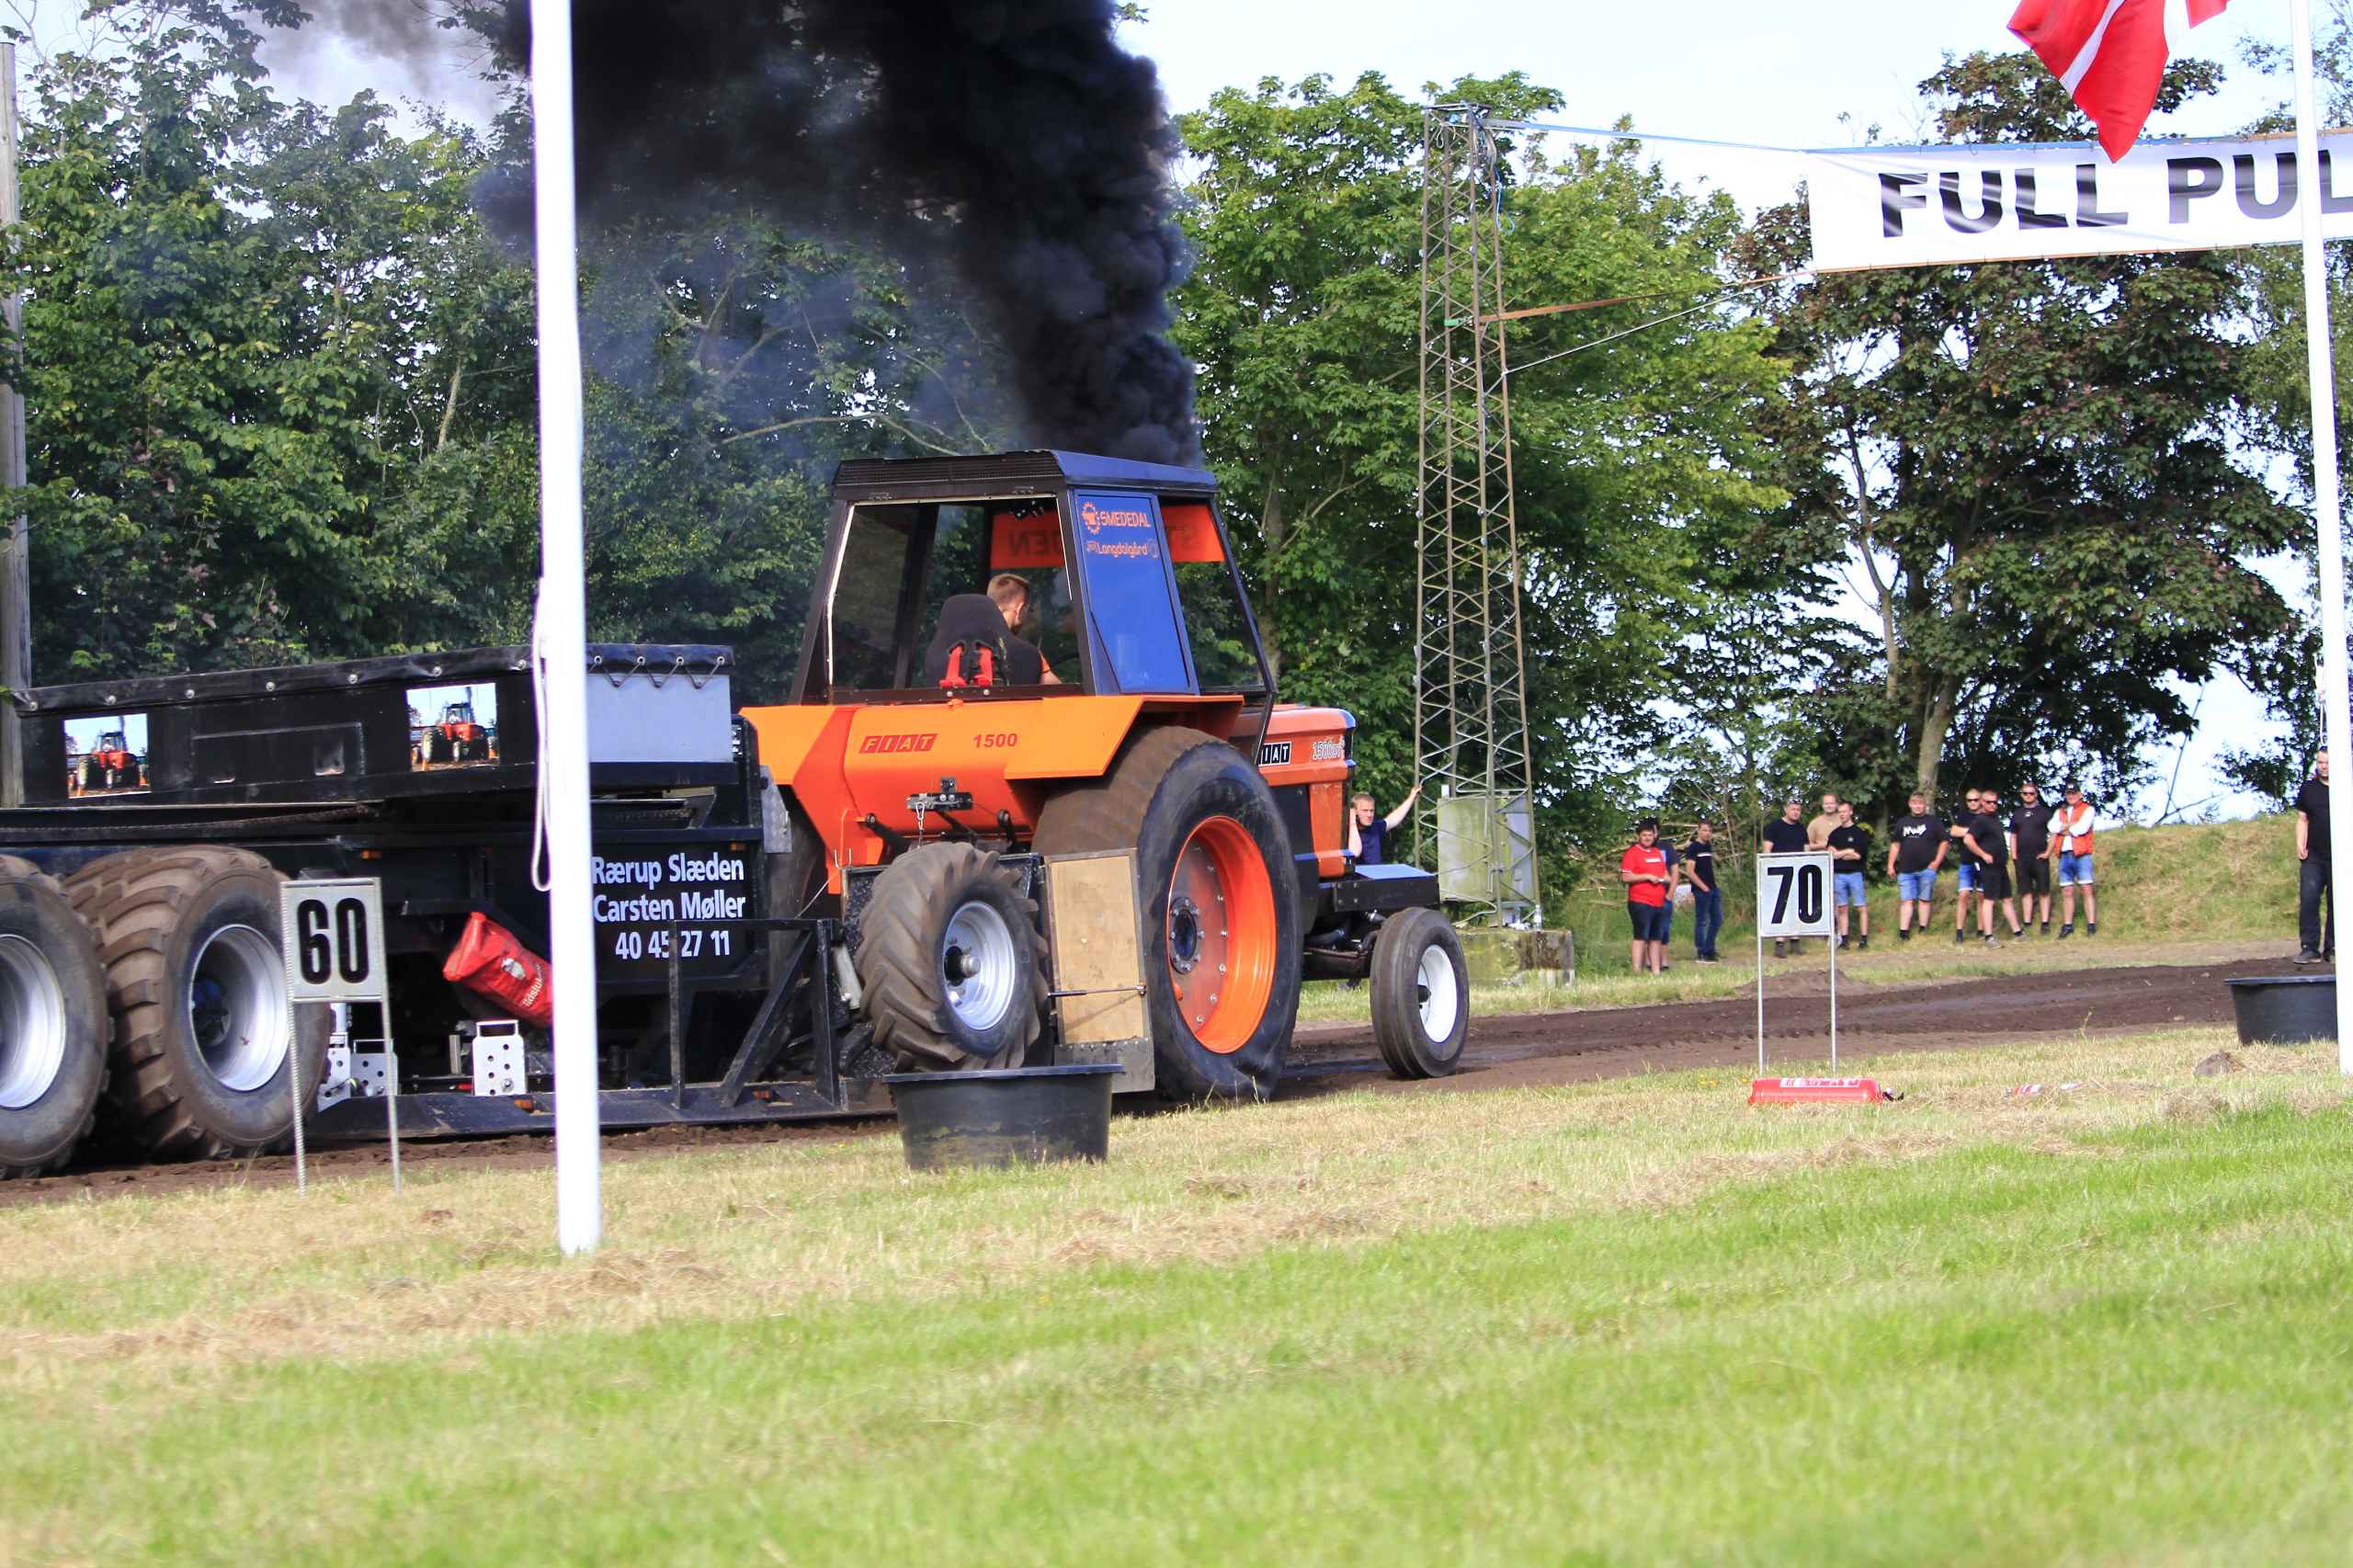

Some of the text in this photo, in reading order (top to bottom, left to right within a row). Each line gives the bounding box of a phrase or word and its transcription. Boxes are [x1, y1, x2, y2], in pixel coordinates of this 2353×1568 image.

[1879, 164, 2129, 238] FULL
[860, 734, 936, 754] FIAT
[972, 733, 1017, 748] 1500
[1262, 743, 1290, 764] IAT
[591, 852, 744, 890] Rærup Slæden
[594, 890, 745, 922] Carsten Møller
[1768, 865, 1822, 924] 70
[297, 898, 369, 985] 60
[615, 930, 730, 960] 40 45 27 11
